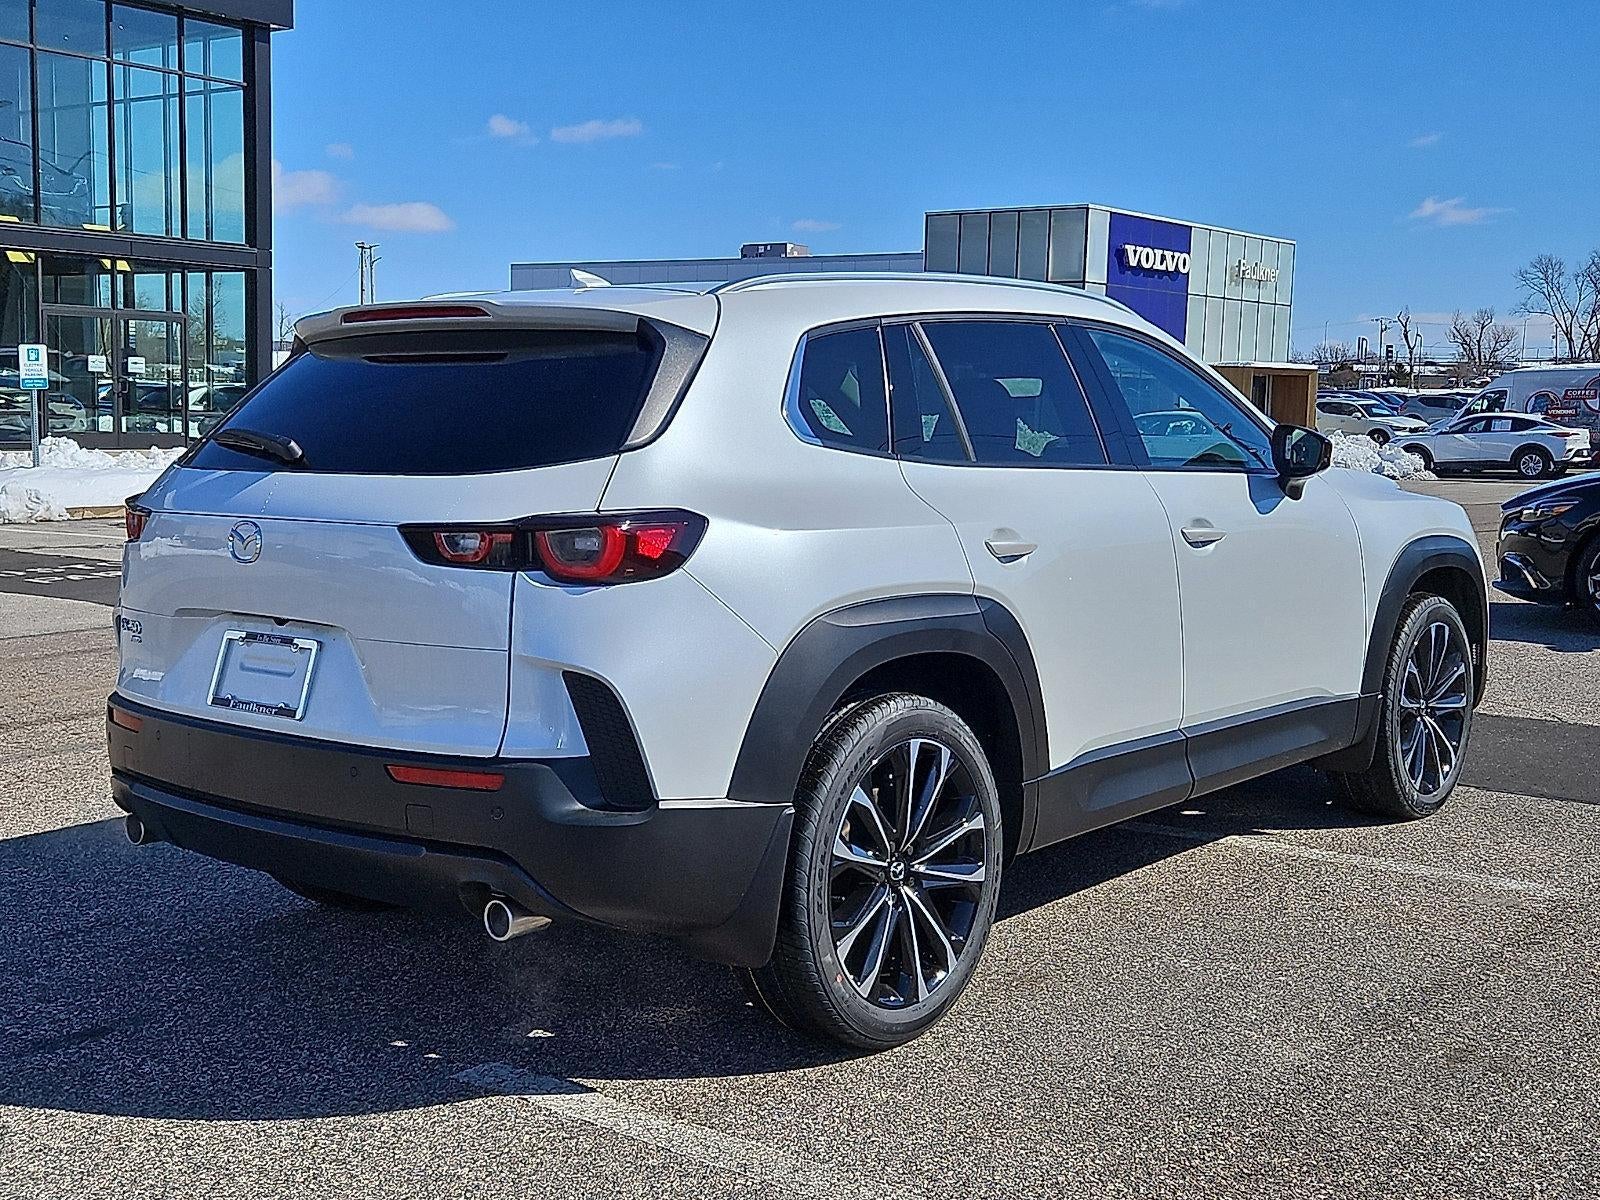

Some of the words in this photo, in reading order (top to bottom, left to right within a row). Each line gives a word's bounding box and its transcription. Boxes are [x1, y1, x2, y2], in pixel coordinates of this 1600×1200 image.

[1124, 244, 1191, 274] VOLVO
[1239, 258, 1279, 282] Faulkner
[229, 699, 278, 715] Faulkner
